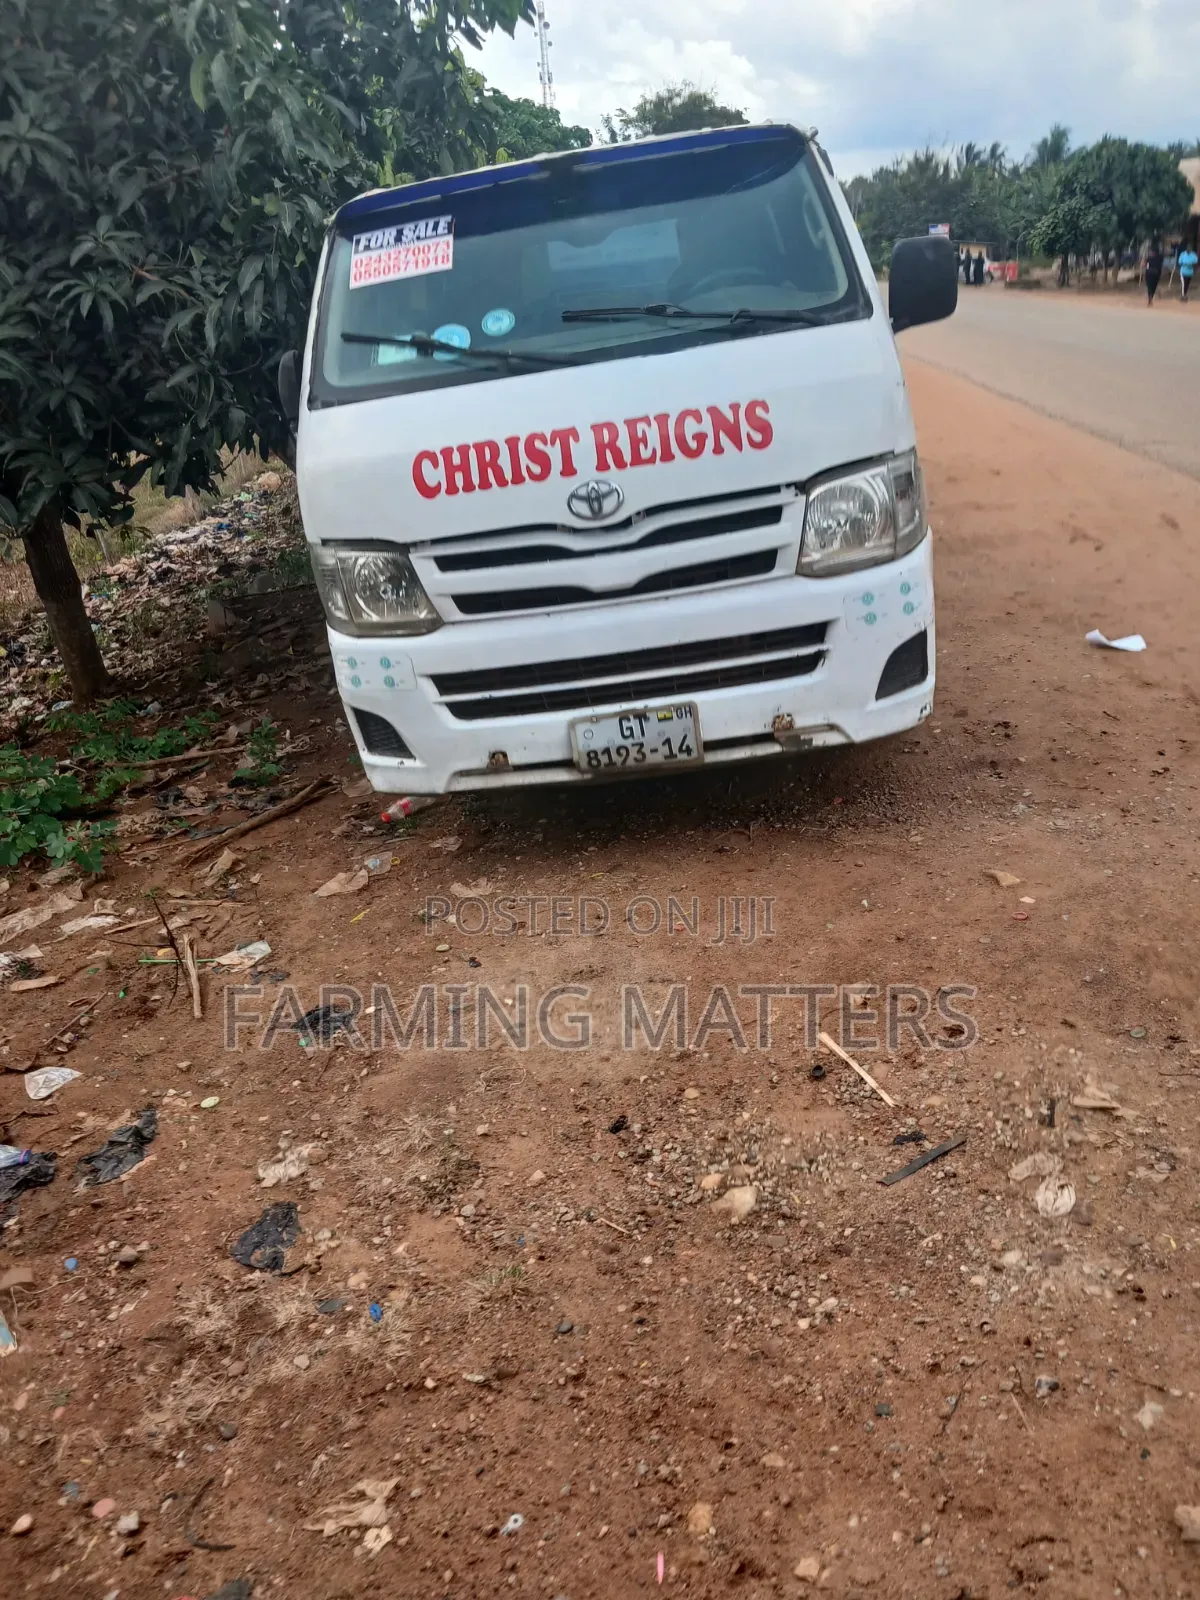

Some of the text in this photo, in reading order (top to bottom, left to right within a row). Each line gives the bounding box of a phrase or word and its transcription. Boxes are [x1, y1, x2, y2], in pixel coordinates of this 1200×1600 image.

[358, 226, 397, 253] FOR
[401, 215, 452, 243] SALE
[412, 399, 774, 499] CHRIST REIGNS
[618, 712, 650, 740] GT
[675, 705, 693, 720] GH
[586, 733, 693, 769] 8193-14
